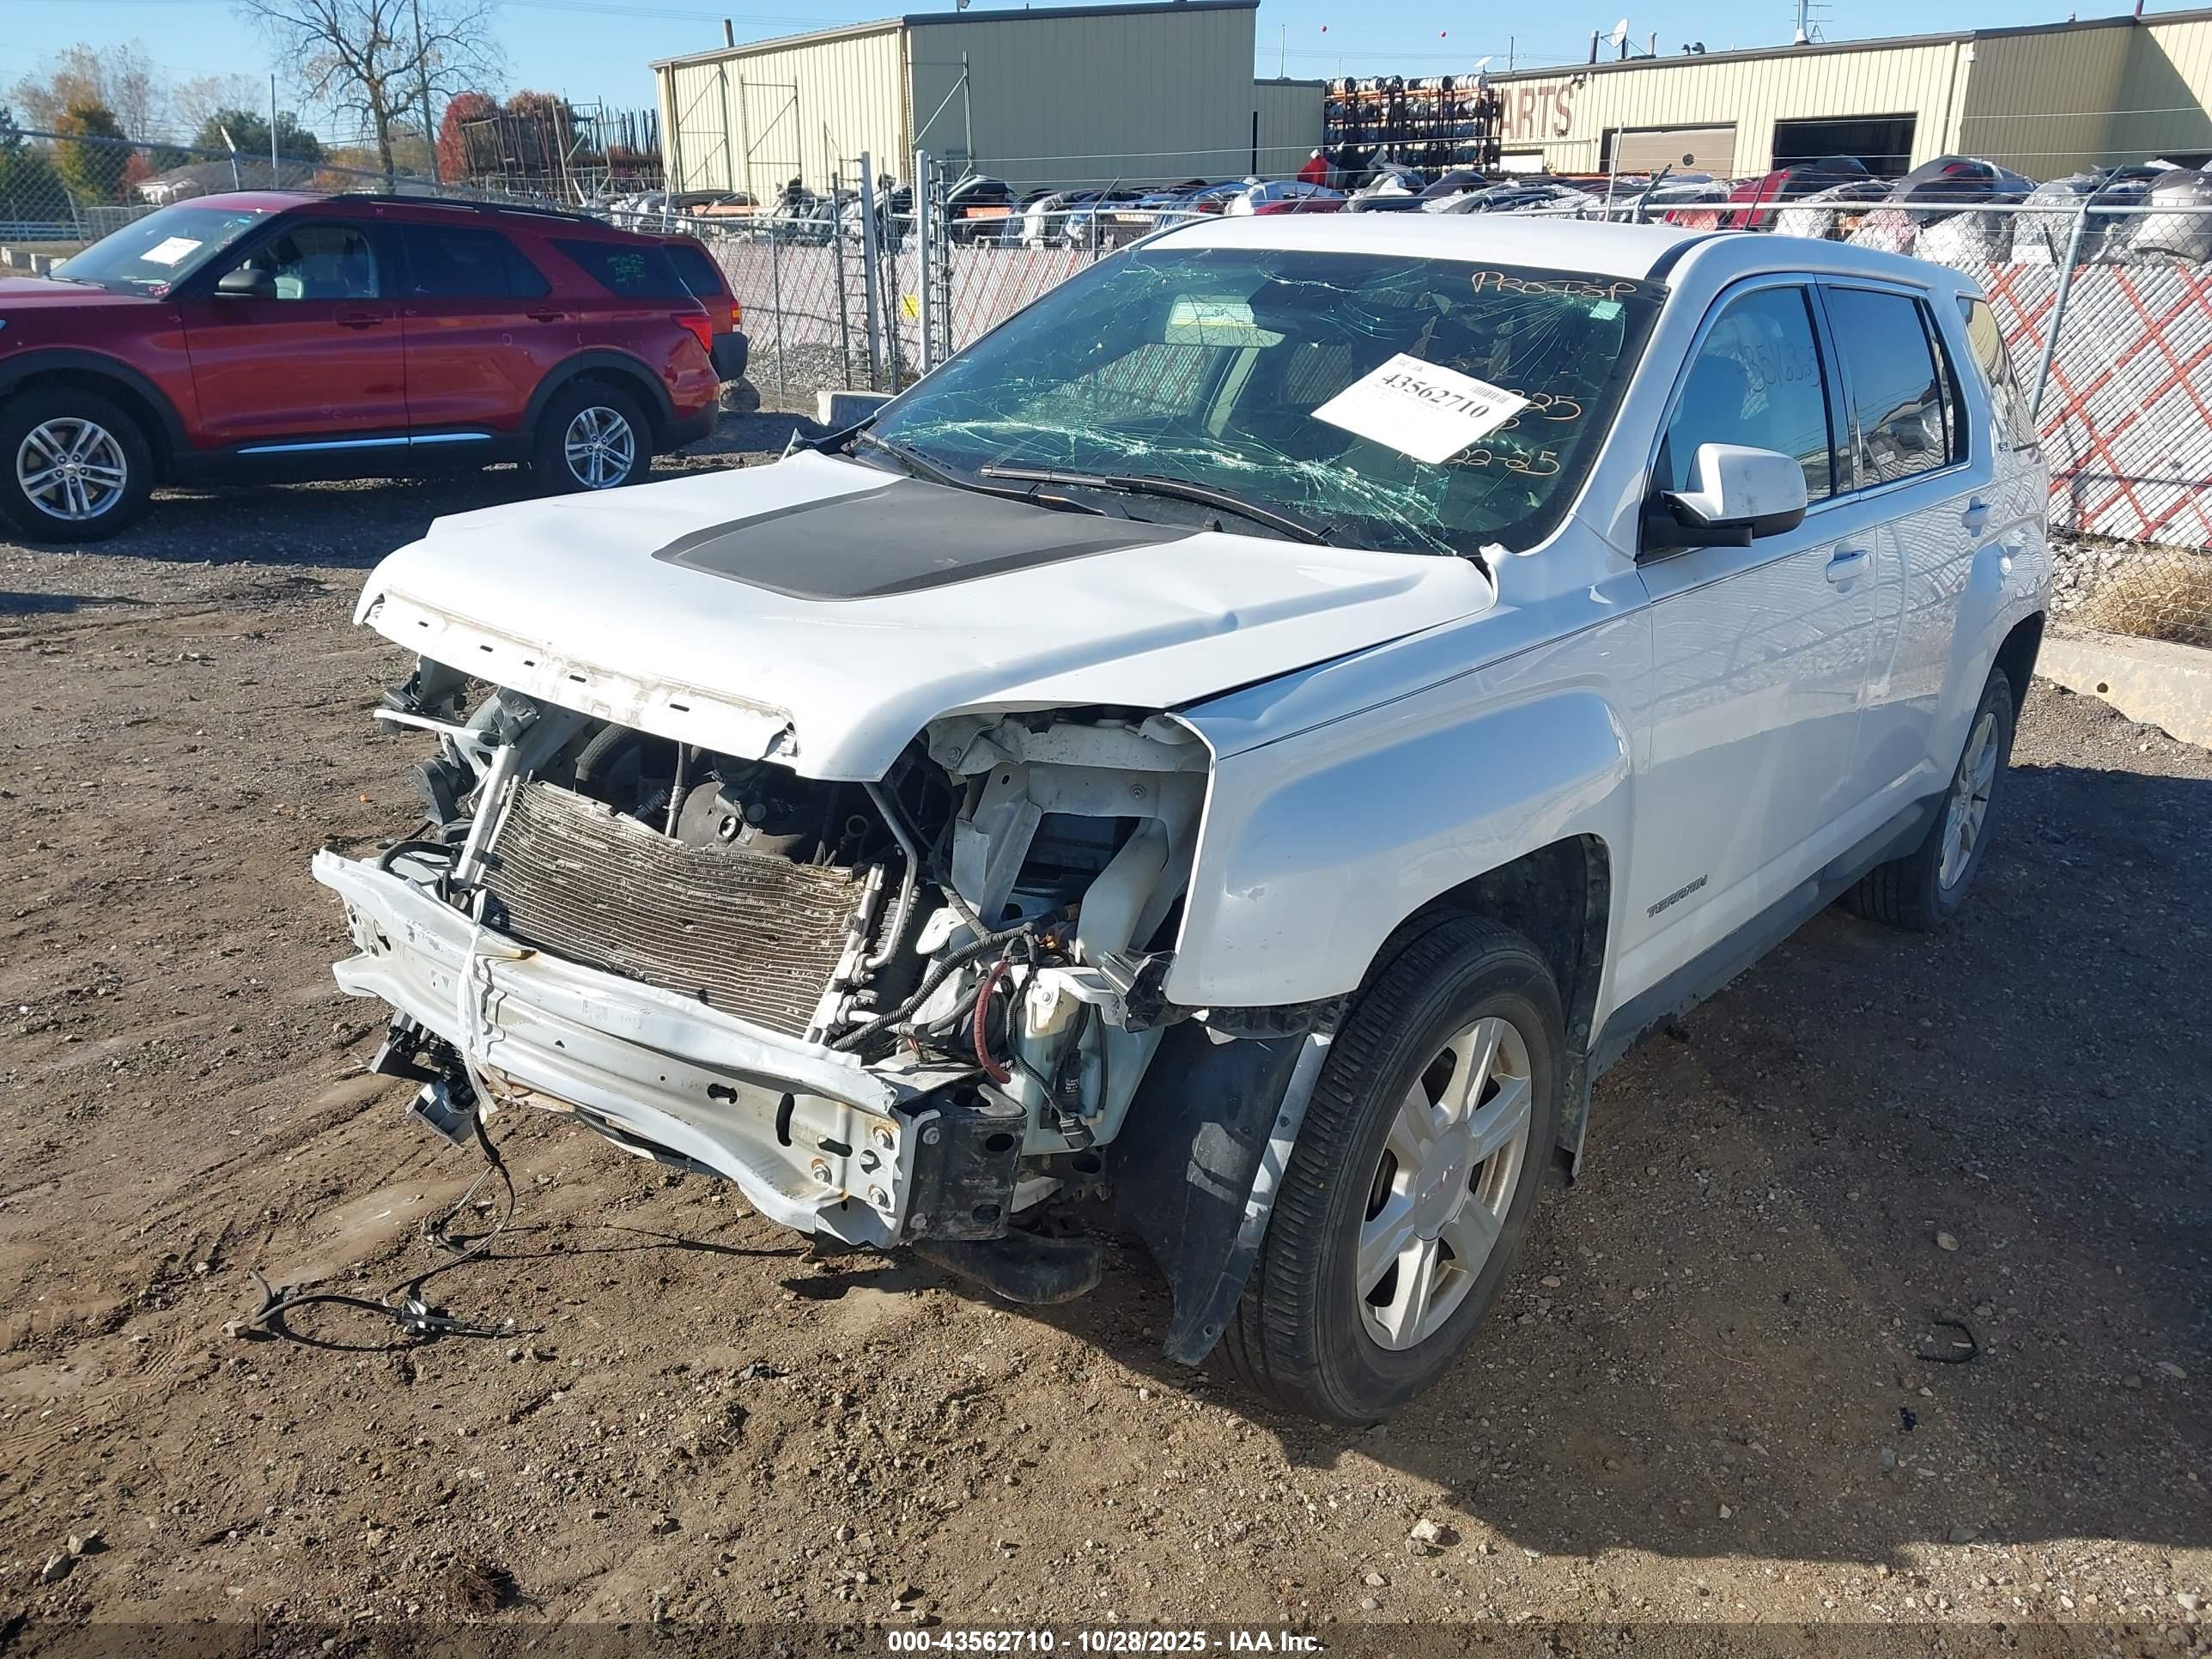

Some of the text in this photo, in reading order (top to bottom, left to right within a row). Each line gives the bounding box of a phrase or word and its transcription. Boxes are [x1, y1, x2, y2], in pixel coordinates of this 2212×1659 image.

[1495, 83, 1574, 138] ARTS
[1382, 373, 1491, 418] 43562710
[1646, 873, 1709, 919] TERRAIN
